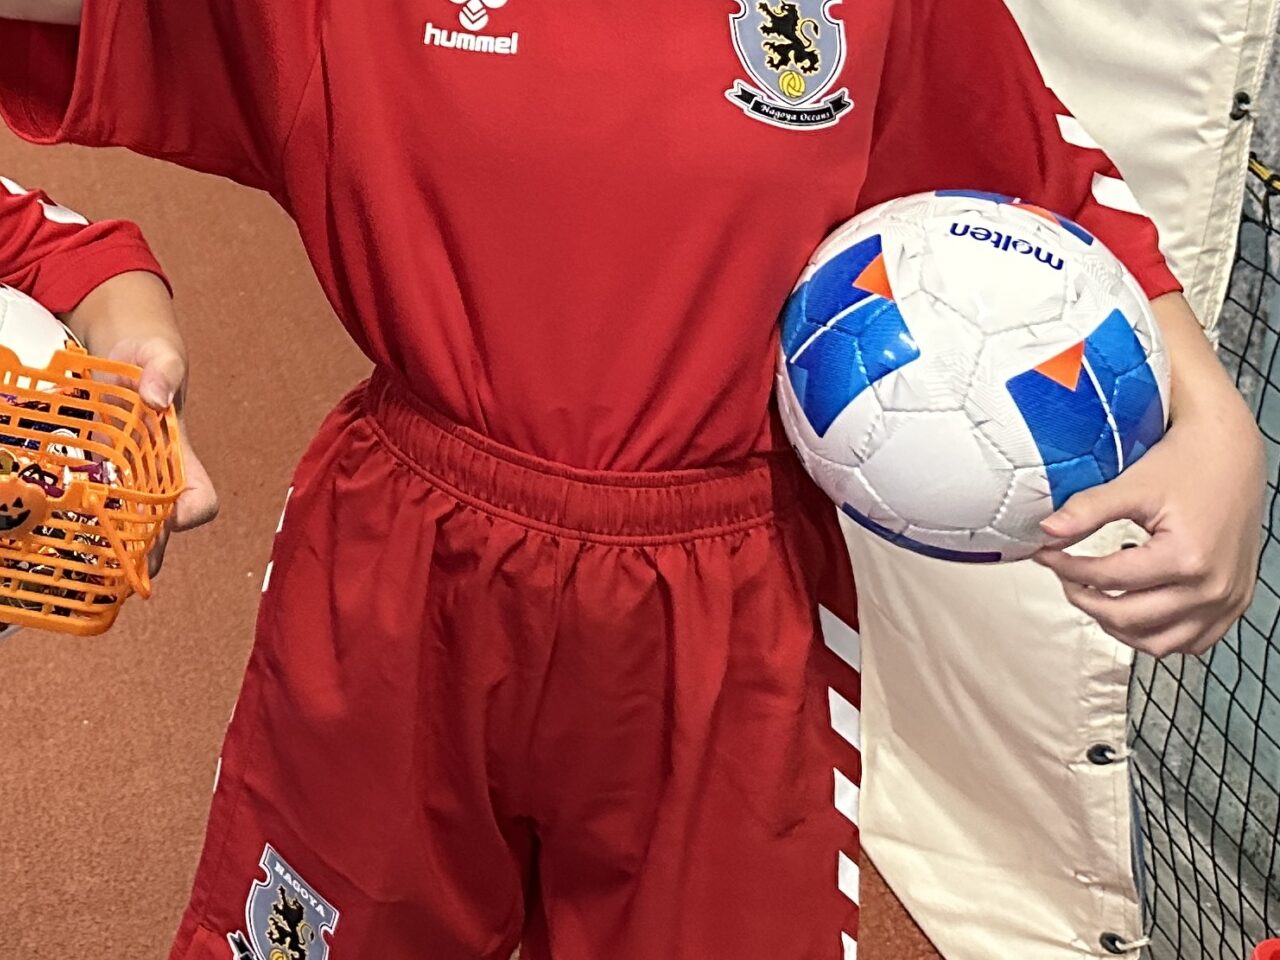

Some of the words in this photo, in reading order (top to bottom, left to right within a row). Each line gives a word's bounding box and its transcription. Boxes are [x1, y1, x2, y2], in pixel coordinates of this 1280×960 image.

[423, 22, 519, 54] hummel
[760, 104, 797, 121] Nagoya
[949, 222, 1065, 271] molten
[273, 861, 326, 918] NAGOYA
